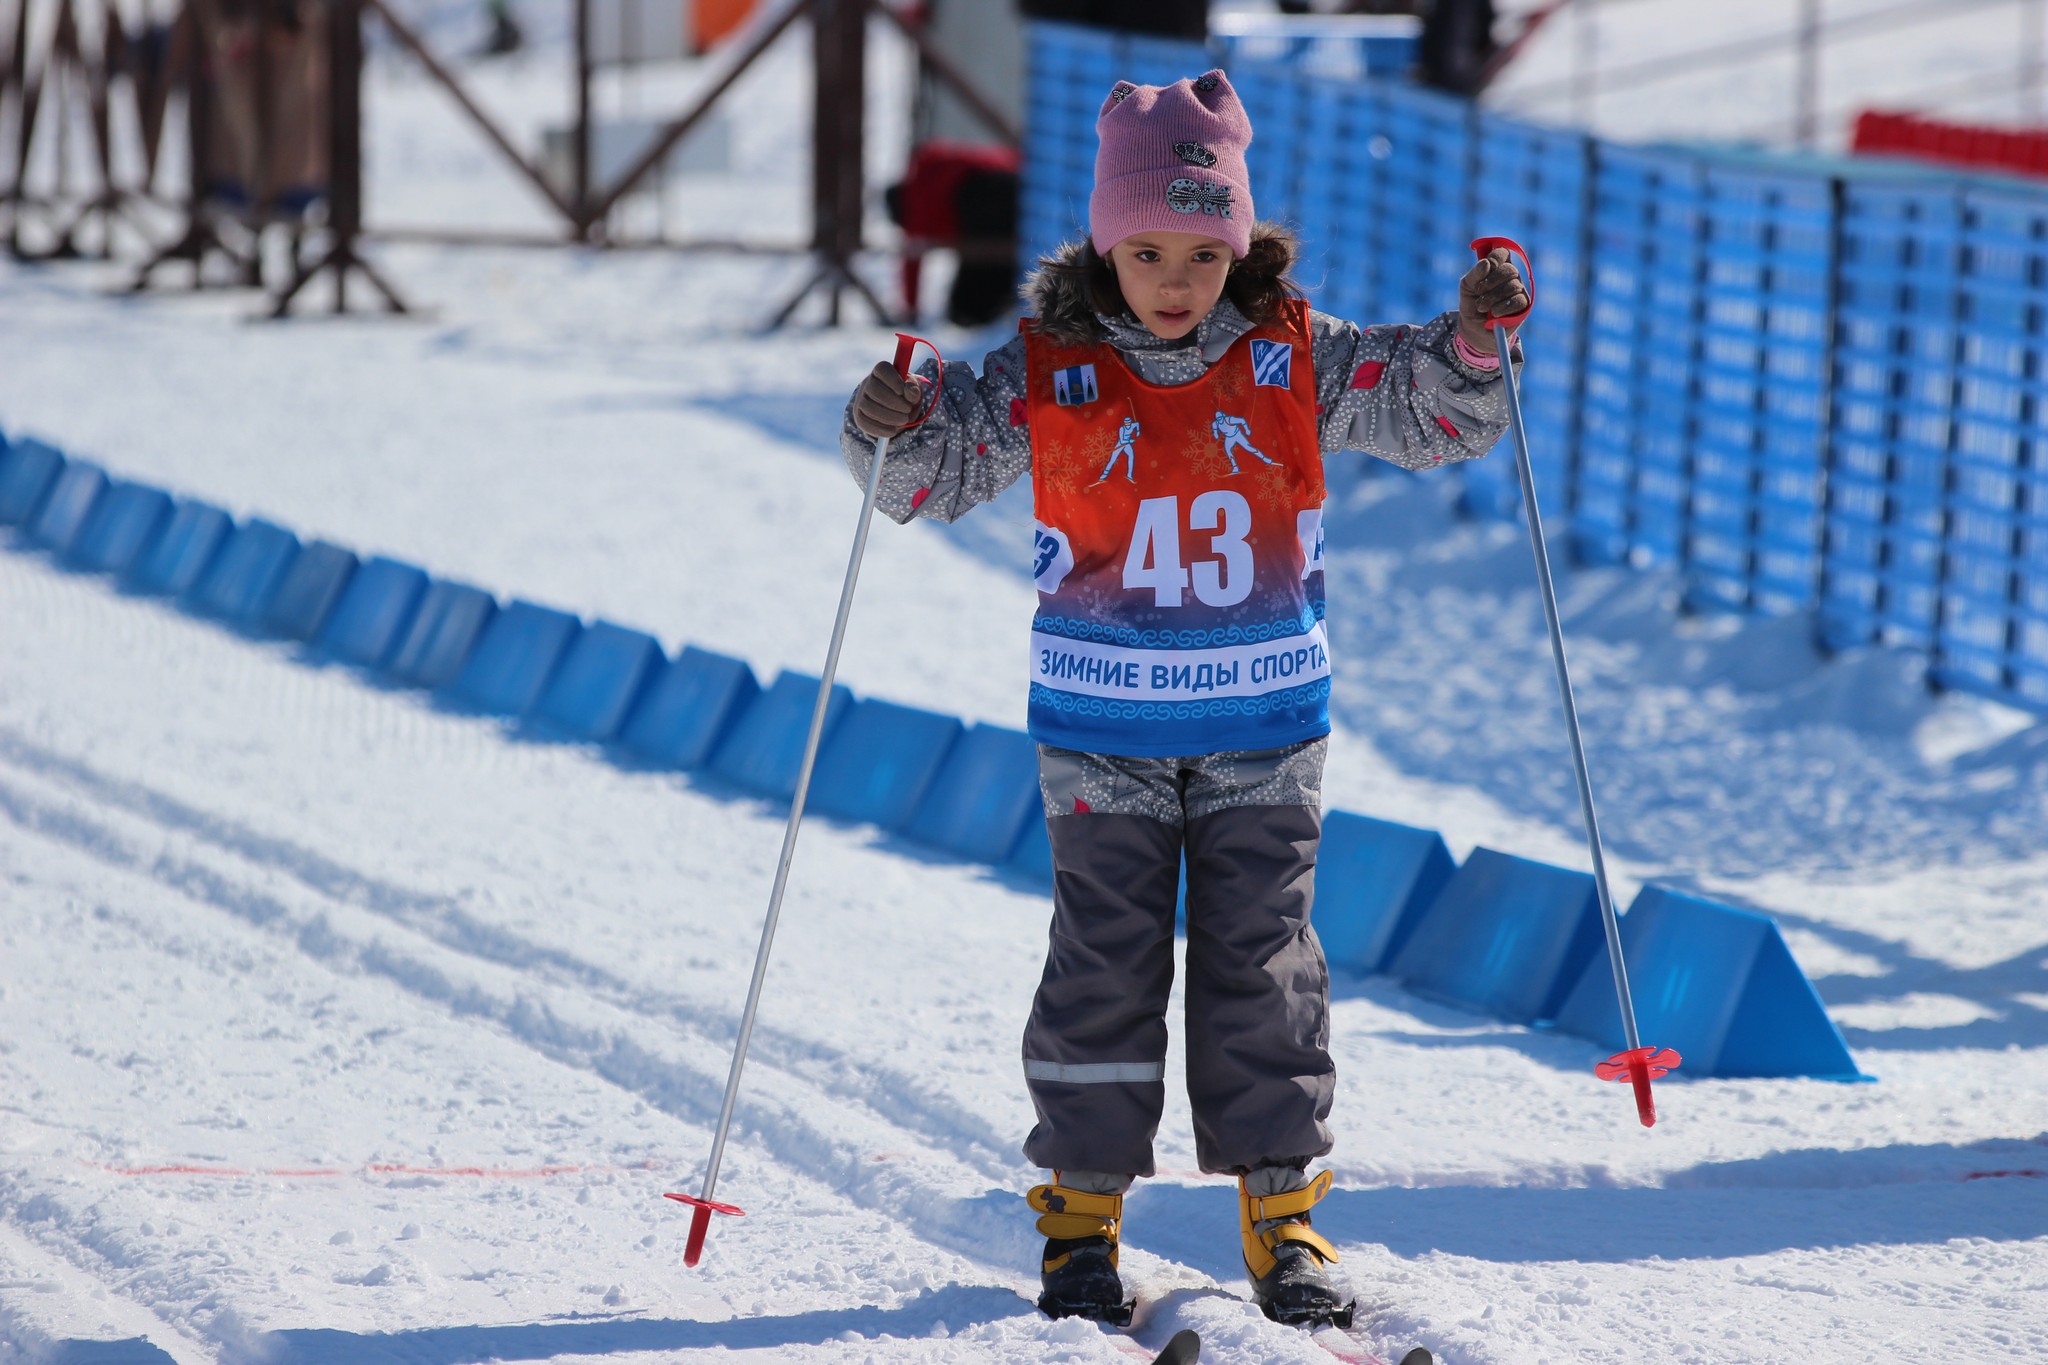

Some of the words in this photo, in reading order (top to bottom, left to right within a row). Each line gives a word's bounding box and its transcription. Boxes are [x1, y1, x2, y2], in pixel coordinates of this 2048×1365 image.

[1167, 178, 1233, 218] OK
[1033, 529, 1060, 580] 3
[1122, 490, 1254, 607] 43
[1040, 649, 1139, 688] ЗИМНИЕ
[1151, 660, 1239, 692] ВИДЫ
[1250, 643, 1328, 684] СПОРТА
